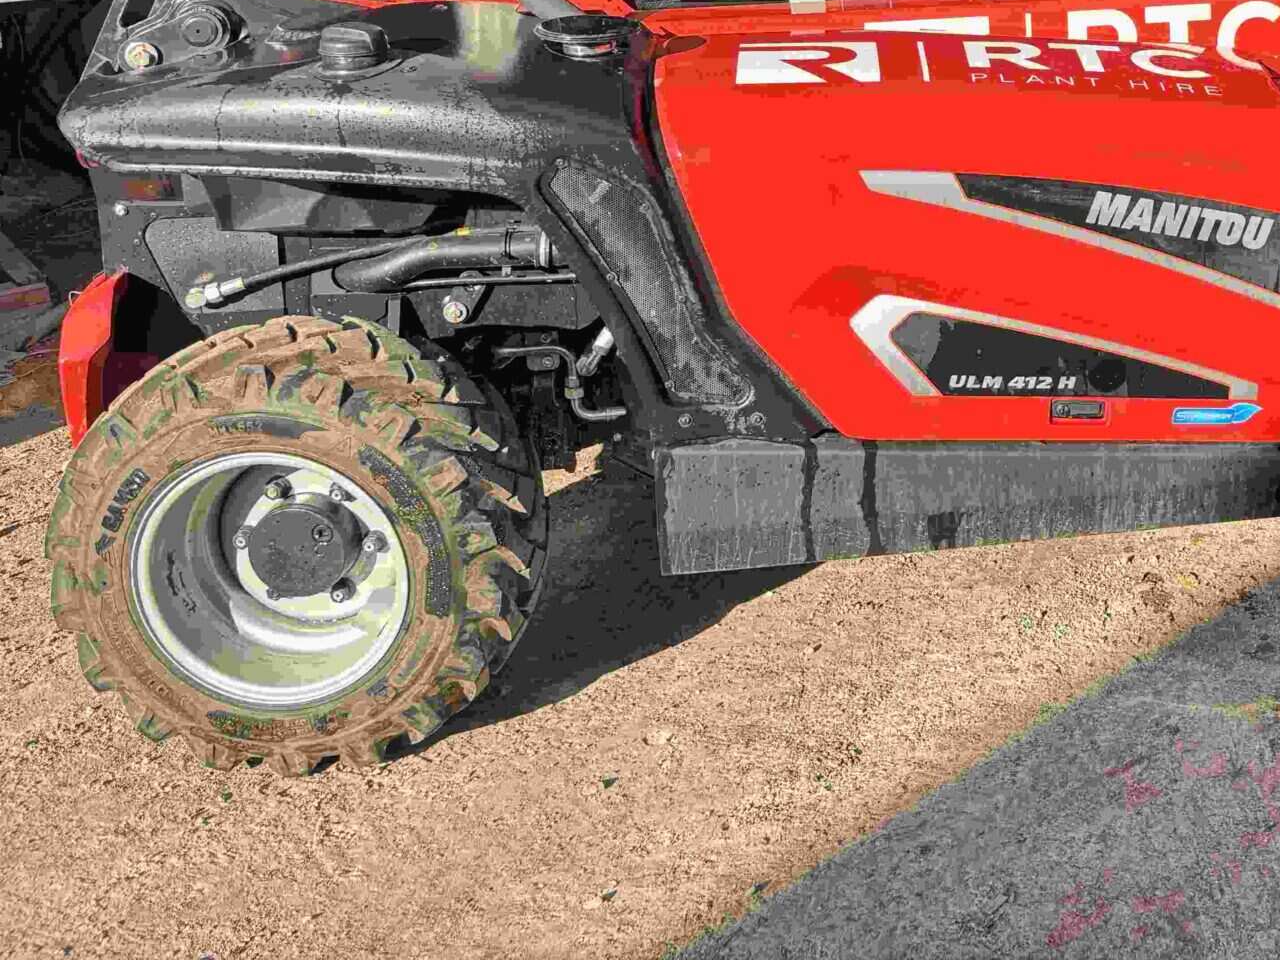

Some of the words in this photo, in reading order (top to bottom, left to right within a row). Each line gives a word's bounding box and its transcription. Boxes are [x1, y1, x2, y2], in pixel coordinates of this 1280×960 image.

[962, 41, 1212, 79] RTC
[970, 72, 1101, 88] PLANT
[1129, 79, 1223, 97] HIRE
[1085, 190, 1275, 251] MANITOU
[949, 374, 1003, 389] ULM
[1007, 375, 1053, 390] 412
[1058, 375, 1078, 389] H
